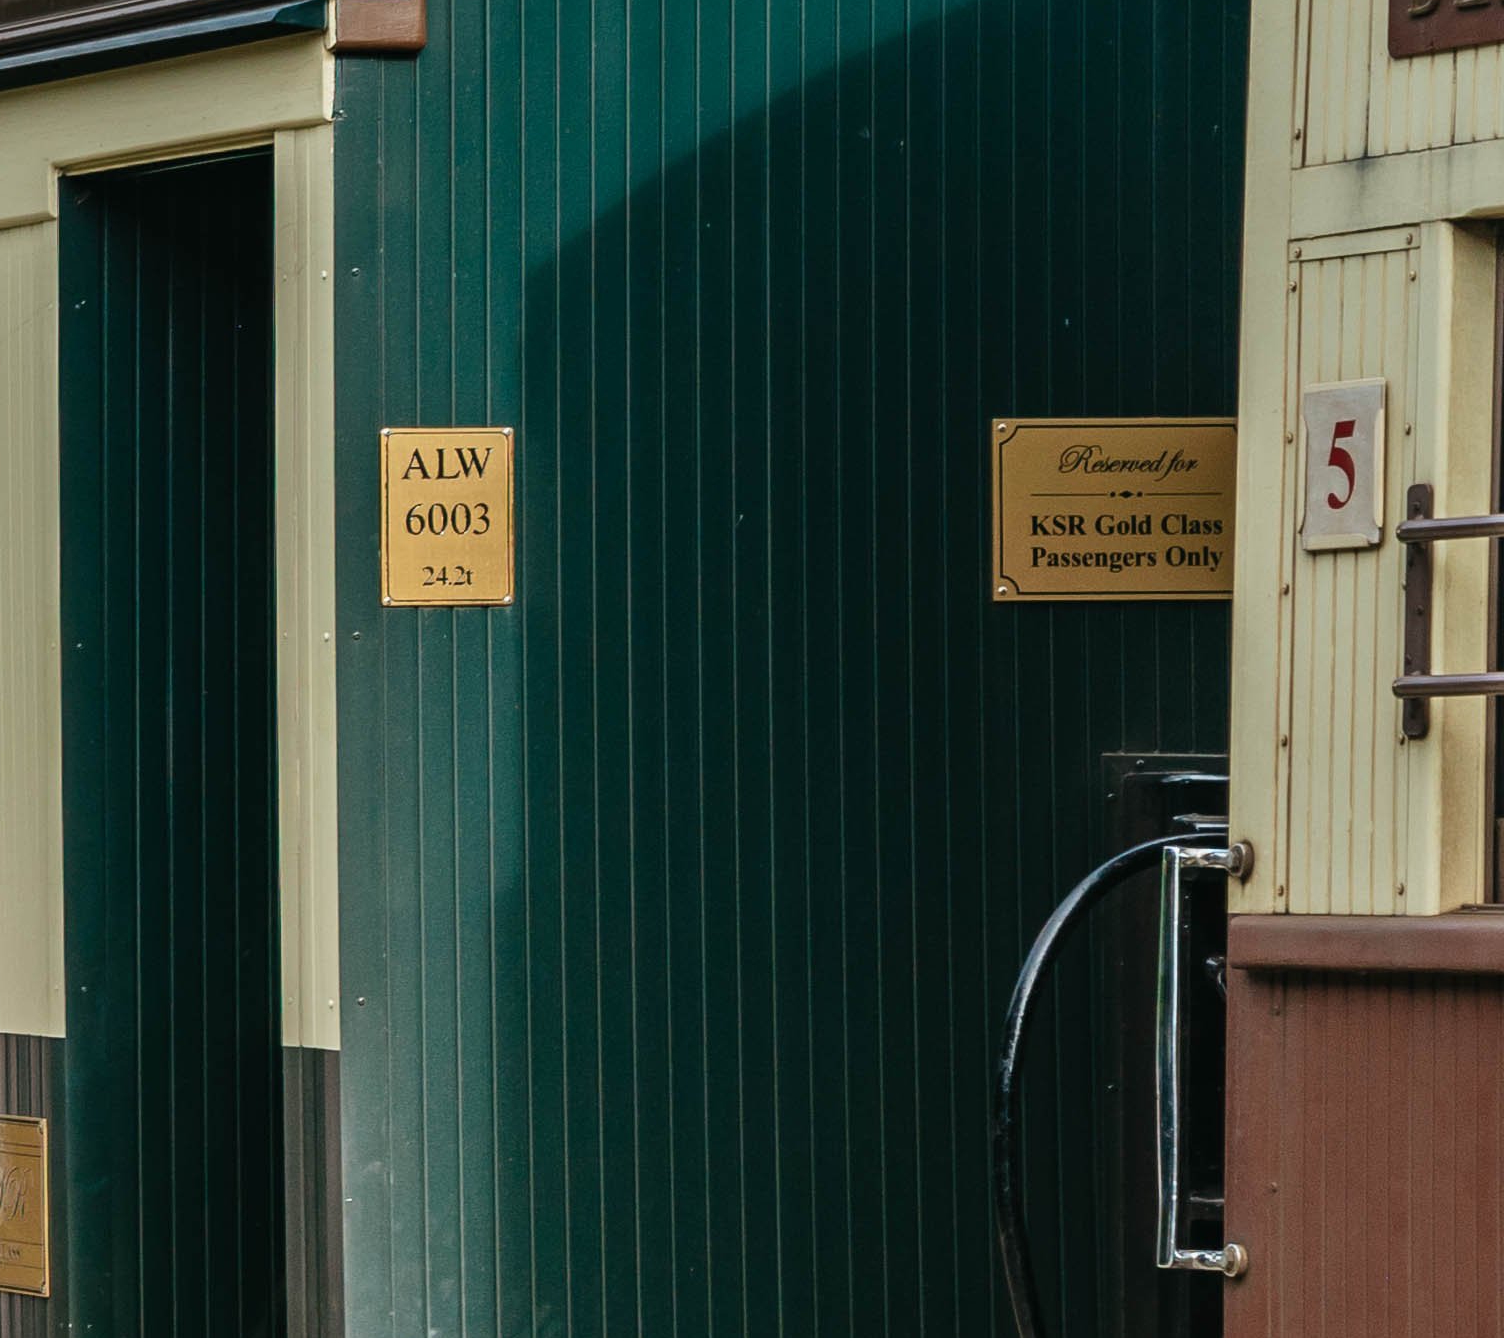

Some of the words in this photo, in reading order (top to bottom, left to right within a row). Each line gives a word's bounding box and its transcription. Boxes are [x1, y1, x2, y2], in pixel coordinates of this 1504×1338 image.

[401, 447, 493, 480] ALW
[1058, 445, 1168, 474] Reserved
[1154, 449, 1199, 482] for
[1328, 420, 1356, 510] 5
[405, 502, 491, 536] 6003
[1031, 514, 1087, 536] KSR
[1094, 514, 1152, 536] Gold
[1160, 513, 1224, 536] Class
[422, 566, 475, 587] 24.2t
[1031, 547, 1157, 574] Passengers
[1165, 546, 1224, 572] Only
